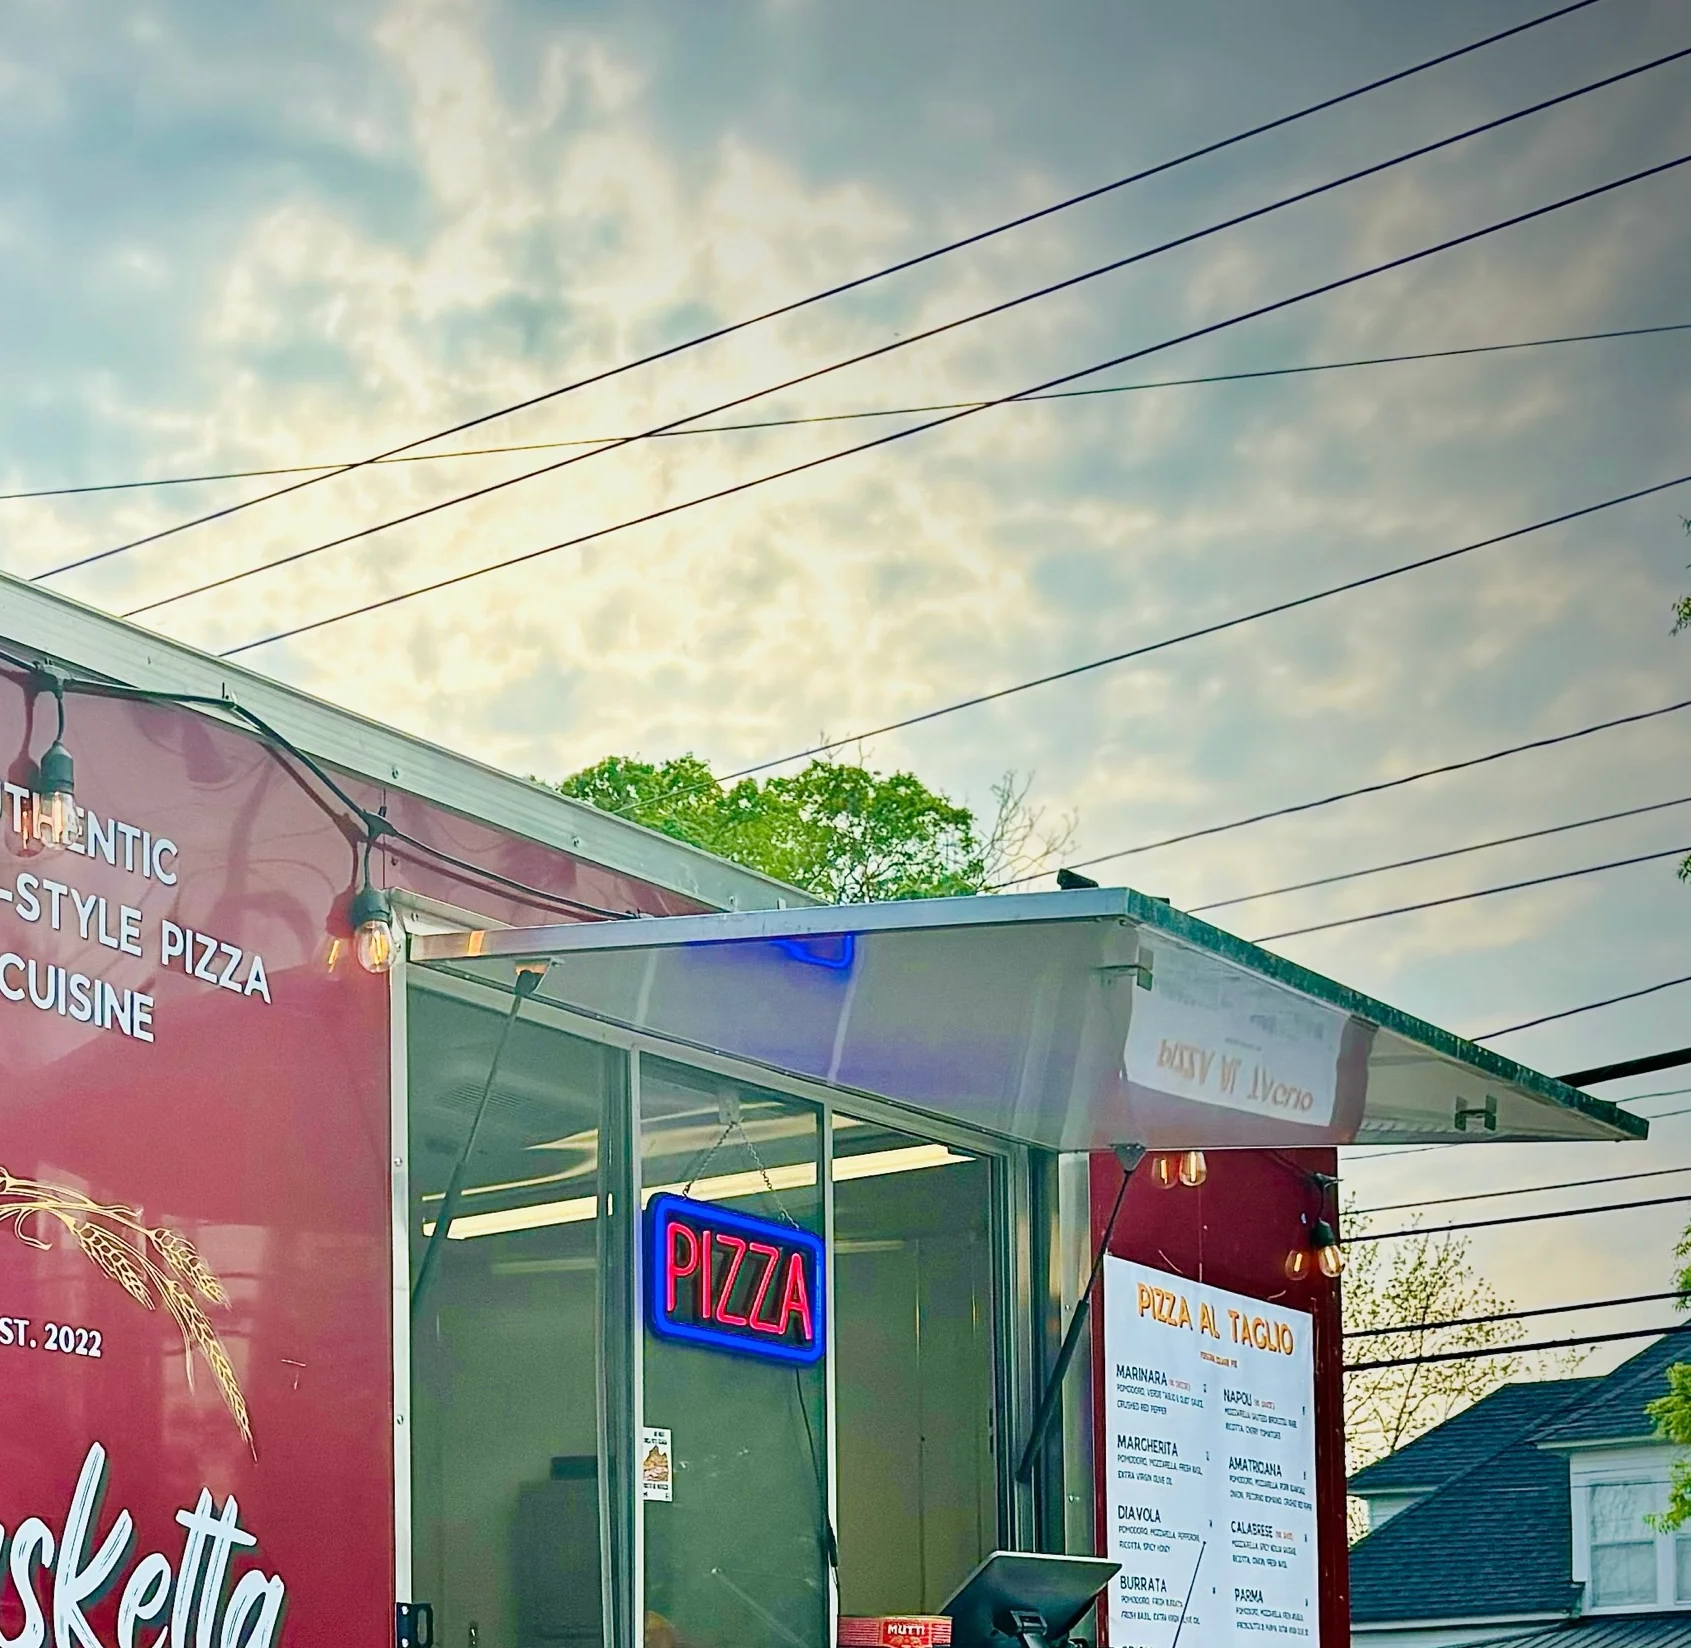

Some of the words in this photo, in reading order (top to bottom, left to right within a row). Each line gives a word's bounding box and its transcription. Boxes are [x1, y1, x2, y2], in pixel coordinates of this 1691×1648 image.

[161, 918, 273, 1005] PIZZA
[666, 1221, 812, 1340] PIZZA
[1137, 1282, 1193, 1331] PIZZA
[1199, 1302, 1220, 1339] AL
[1227, 1309, 1294, 1355] TAGLIO
[44, 1321, 103, 1358] 2022
[1116, 1364, 1168, 1386] MARINARA
[1117, 1434, 1179, 1457] MARGHERITA
[1118, 1505, 1161, 1523] DIAVOLA
[1231, 1521, 1273, 1539] CALABRESE
[1120, 1576, 1167, 1593] BURRATA
[1234, 1588, 1264, 1604] PARMA
[887, 1624, 925, 1636] MUTTI
